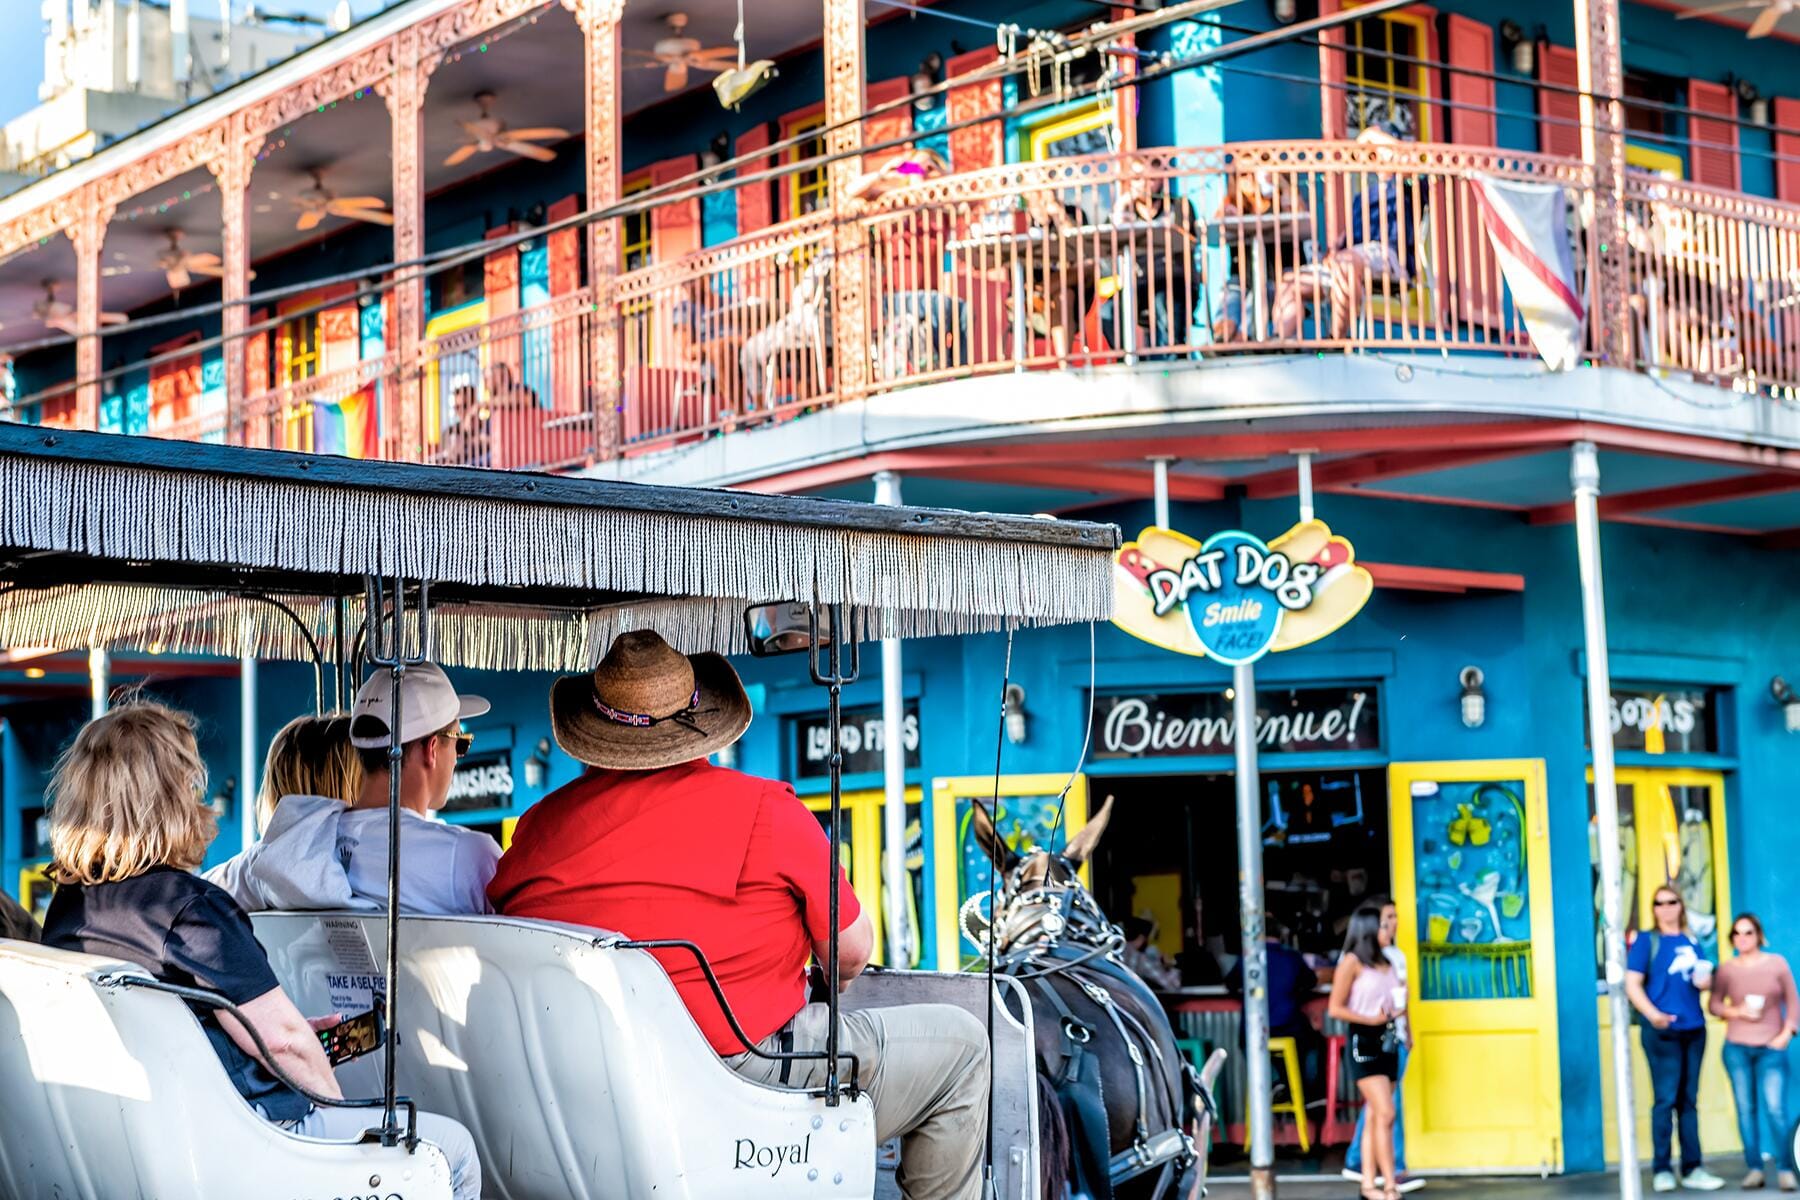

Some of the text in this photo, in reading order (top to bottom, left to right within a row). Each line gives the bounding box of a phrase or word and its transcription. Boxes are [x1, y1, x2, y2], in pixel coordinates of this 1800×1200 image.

[1147, 549, 1226, 616] DAT
[1203, 598, 1263, 627] Smile
[324, 919, 358, 930] WARNING
[327, 975, 350, 989] TAKE
[350, 975, 358, 989] A
[732, 1132, 812, 1178] Royal
